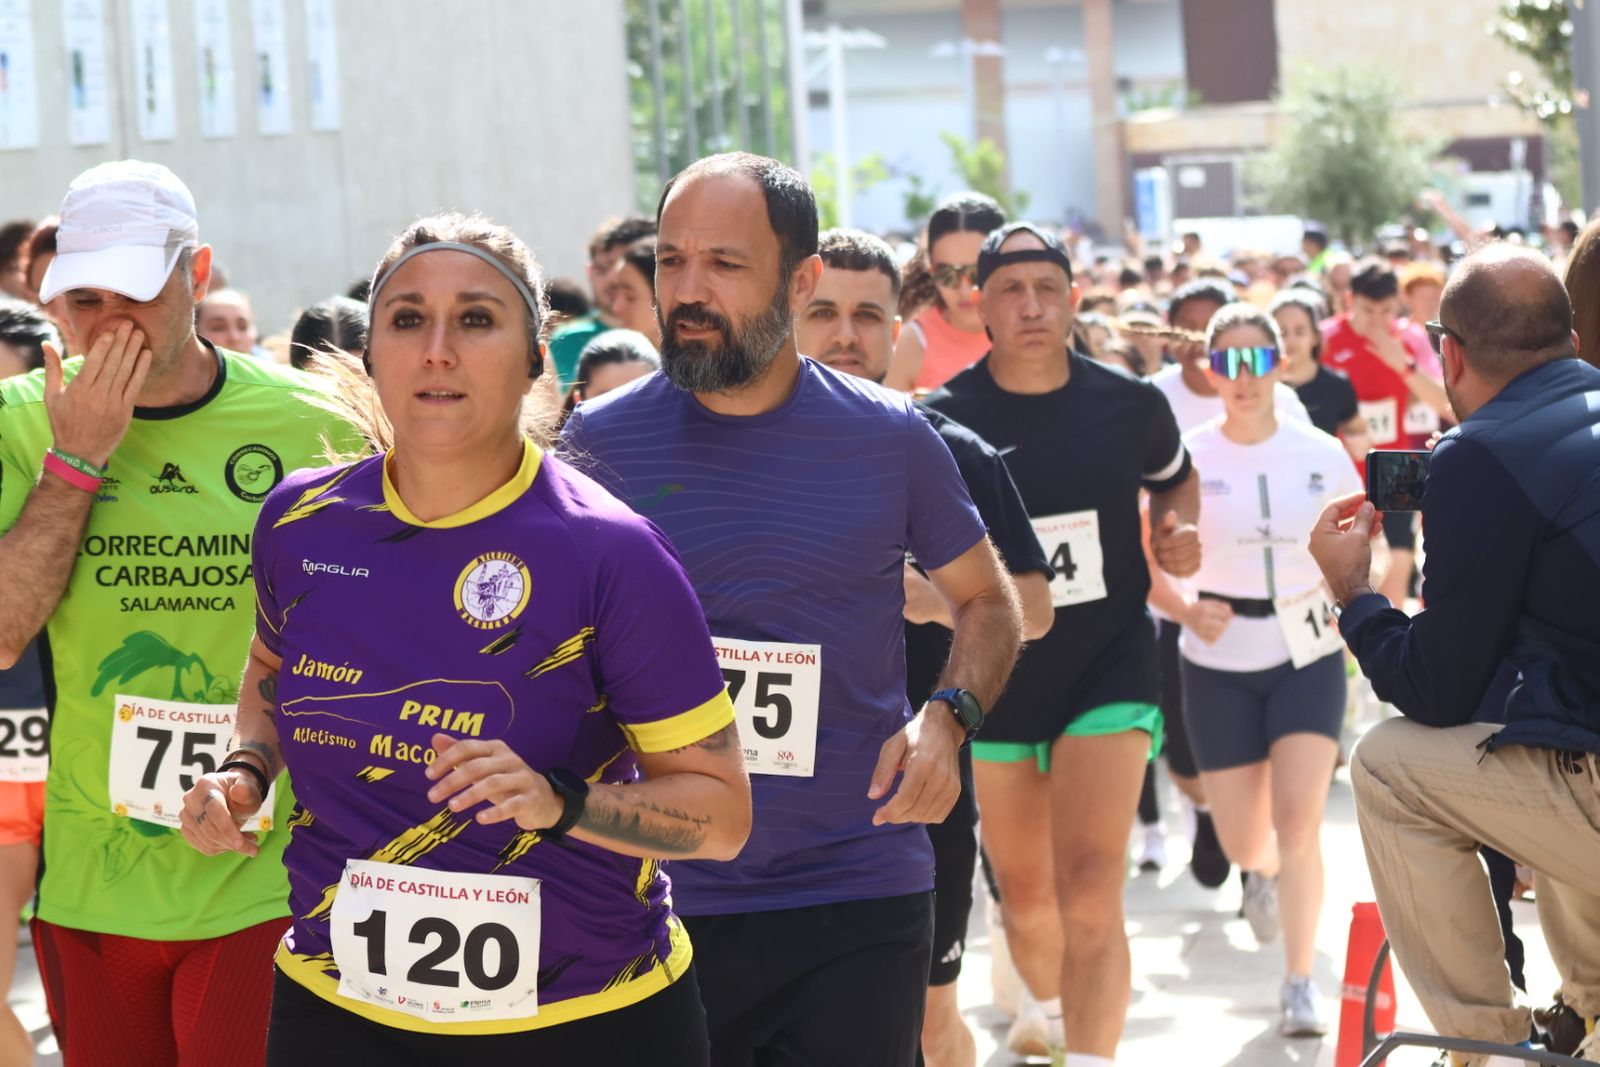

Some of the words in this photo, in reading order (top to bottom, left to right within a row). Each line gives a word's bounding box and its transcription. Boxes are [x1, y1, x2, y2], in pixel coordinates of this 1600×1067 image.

[76, 533, 250, 557] ORRECAMIN
[302, 559, 369, 578] MAGLIA
[1050, 541, 1078, 581] 4
[95, 564, 253, 587] CARBAJOSA
[120, 596, 236, 612] SALAMANCA
[292, 654, 363, 685] Jamón
[765, 652, 774, 662] Y
[777, 651, 816, 665] LEÓN
[148, 708, 165, 720] DE
[169, 711, 231, 724] CASTILLA
[399, 699, 485, 737] PRIM
[0, 716, 49, 757] 29
[293, 727, 357, 749] Atletismo
[136, 726, 233, 792] 75
[350, 872, 373, 888] DÍA
[376, 878, 395, 891] DE
[398, 881, 469, 900] CASTILLA
[472, 889, 483, 901] Y
[486, 889, 530, 905] LEÓN
[353, 909, 520, 991] 120
